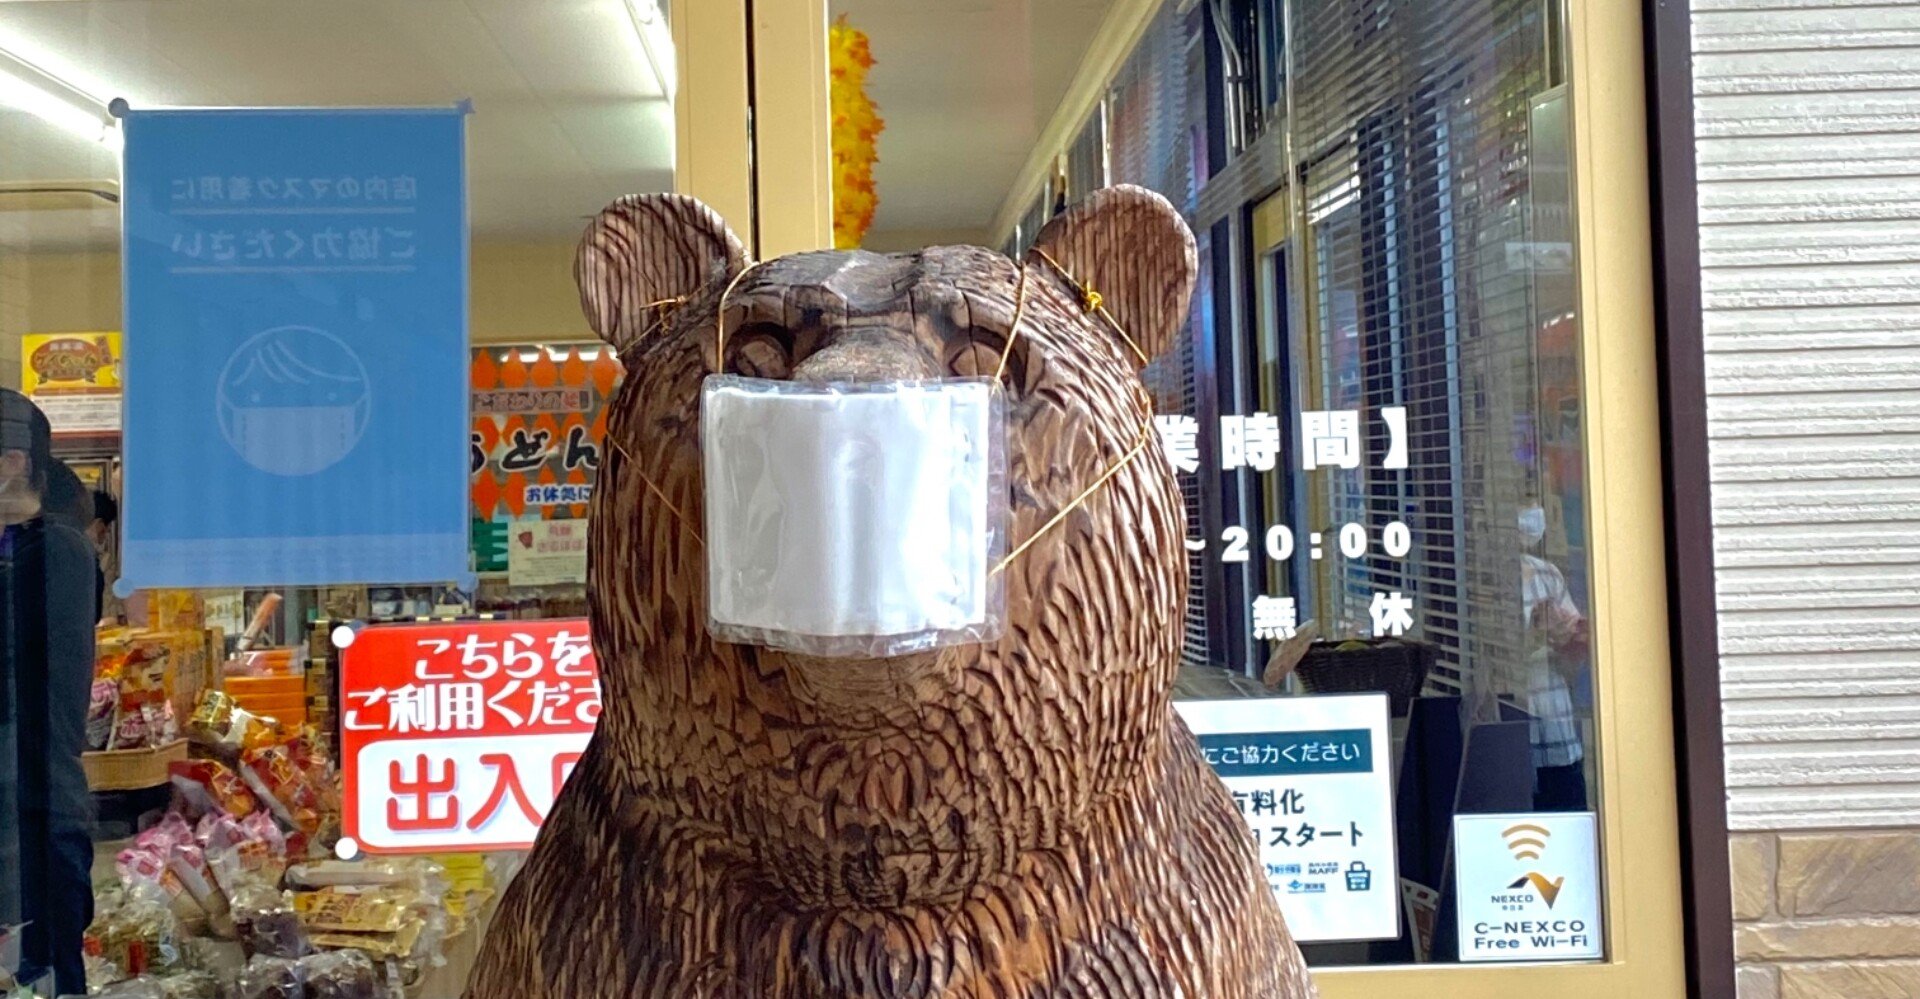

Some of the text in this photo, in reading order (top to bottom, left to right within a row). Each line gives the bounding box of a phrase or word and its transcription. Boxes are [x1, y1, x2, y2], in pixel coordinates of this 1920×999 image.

[415, 631, 593, 680] こちらを
[344, 678, 603, 733] ご利用くださ
[1201, 742, 1361, 765] にご協力ください
[1252, 821, 1363, 848] スタート
[1491, 894, 1534, 904] NEXCO
[1474, 920, 1585, 934] C-NEXCO
[1474, 934, 1588, 949] Free Wi-Fi
